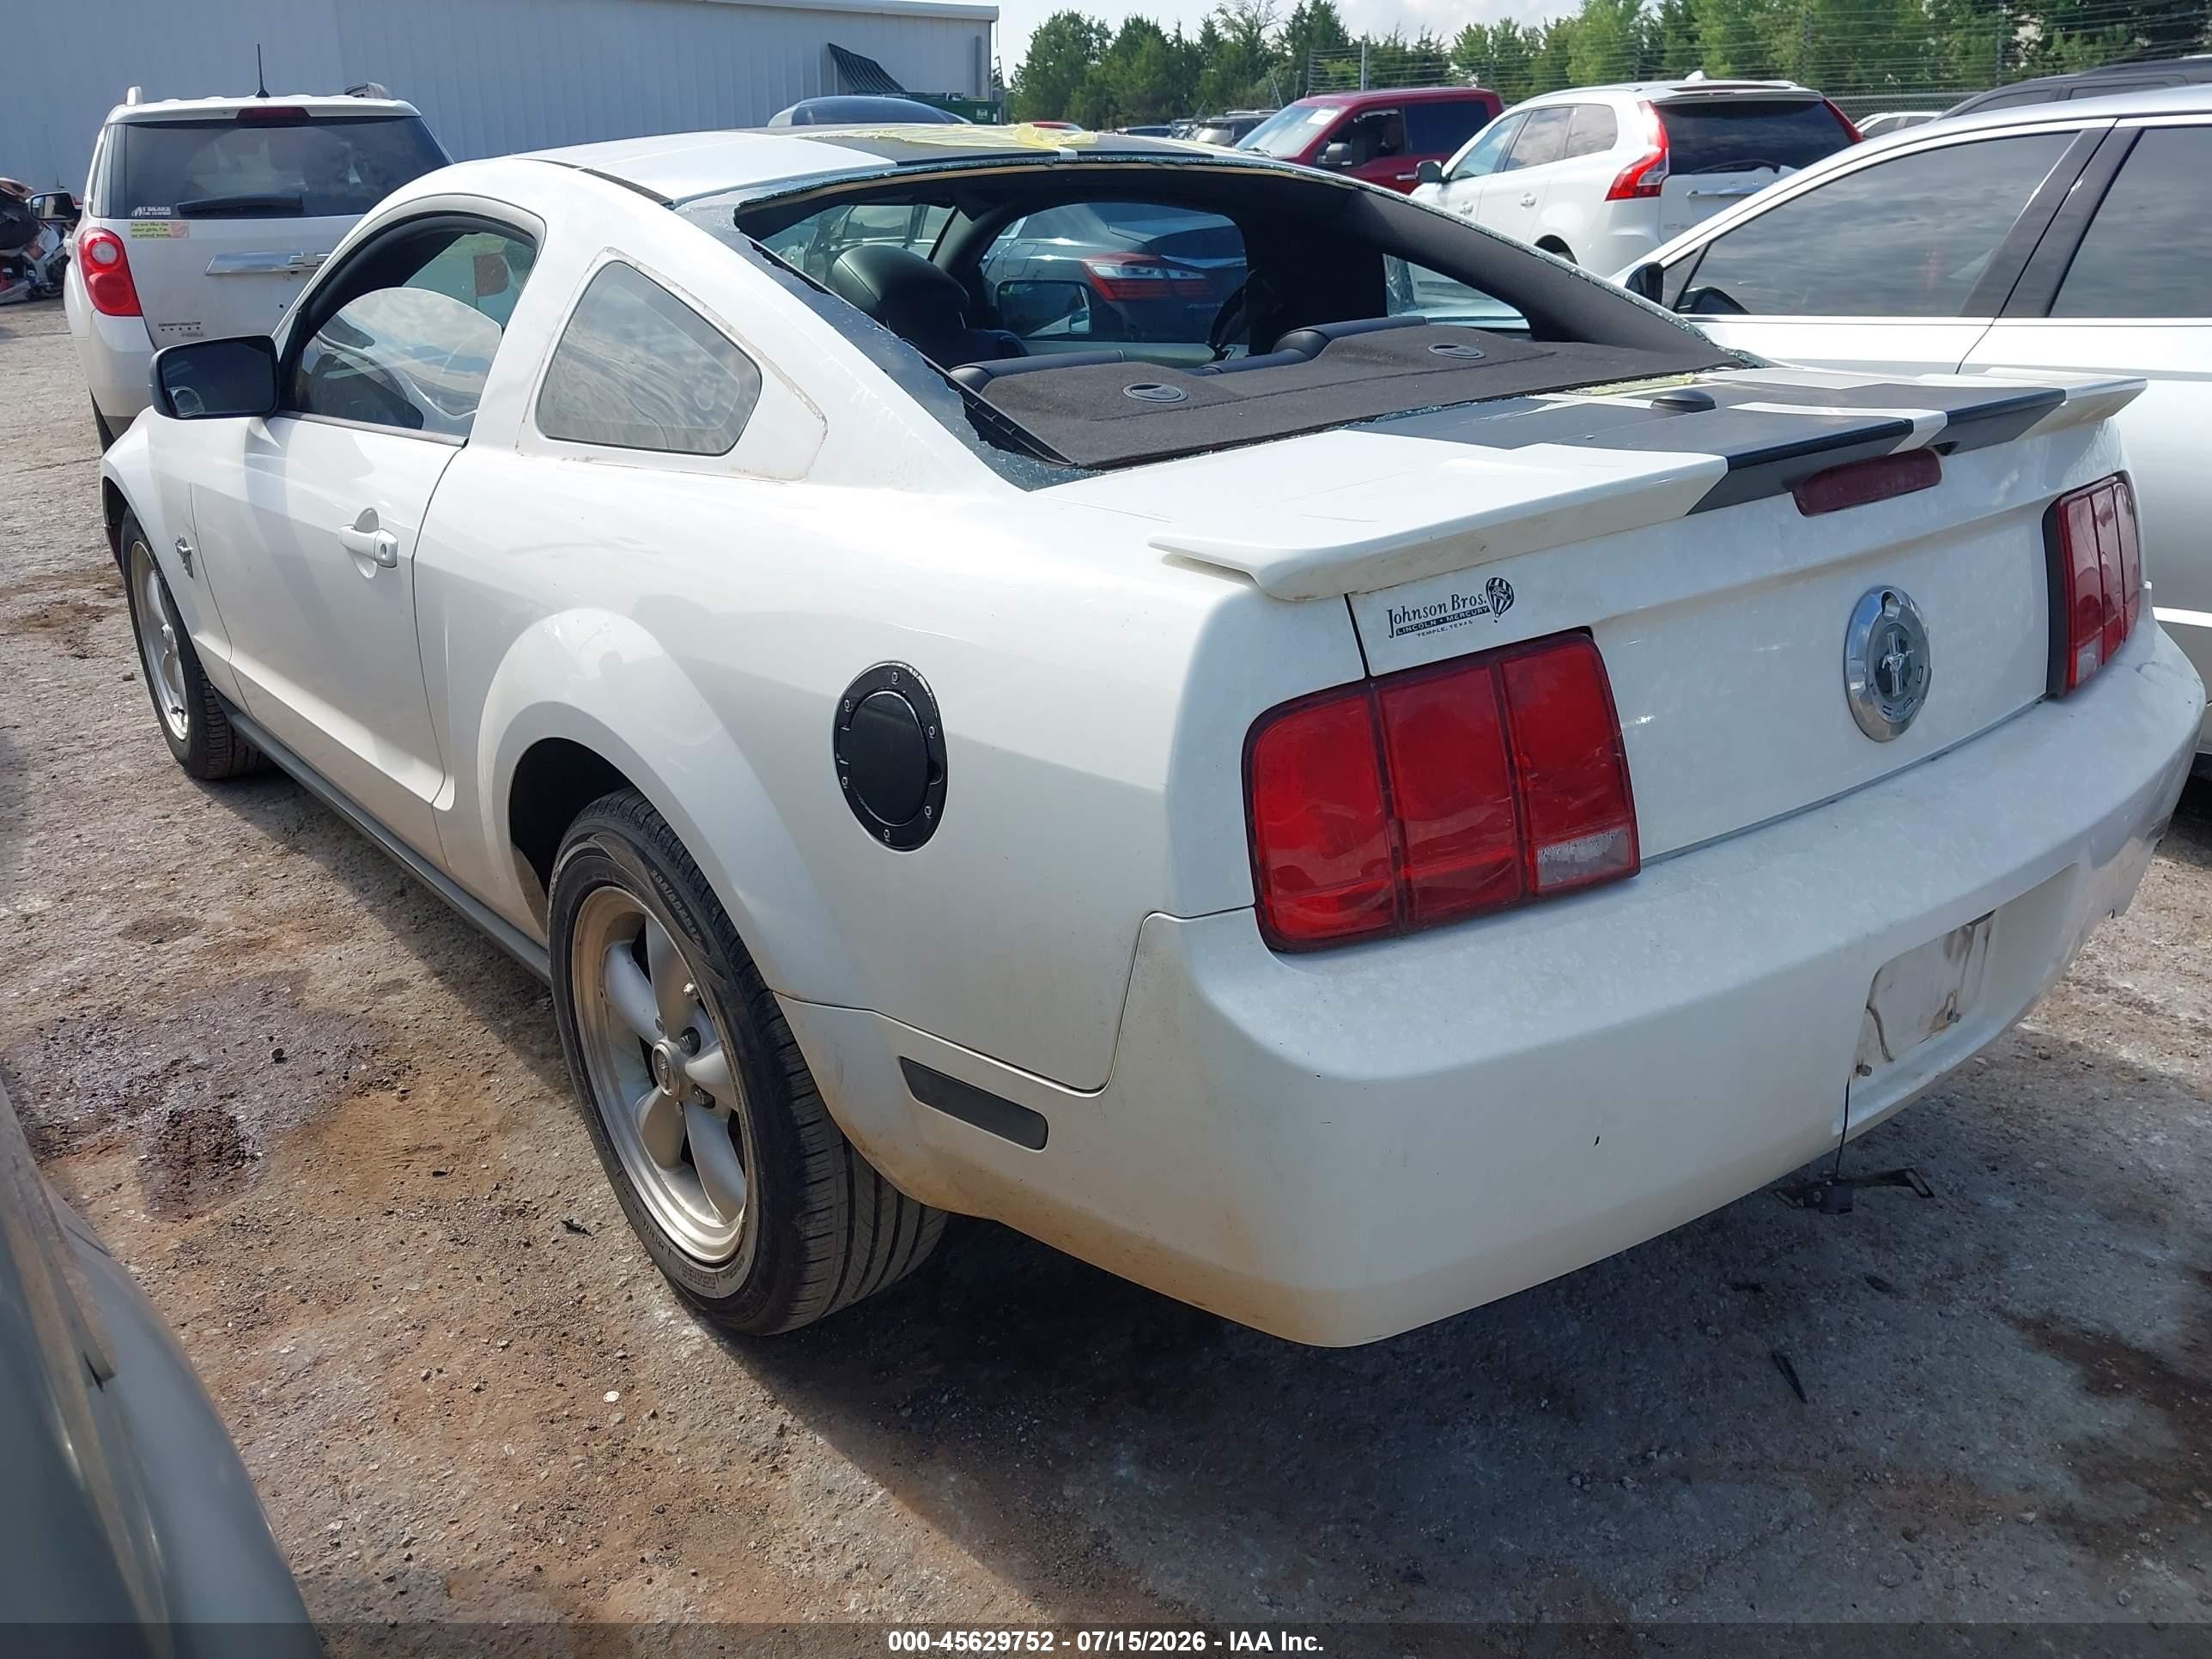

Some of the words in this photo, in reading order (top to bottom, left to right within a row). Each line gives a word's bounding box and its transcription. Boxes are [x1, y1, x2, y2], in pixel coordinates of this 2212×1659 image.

[1387, 603, 1449, 639] Johnson
[1451, 593, 1487, 611] Bros.
[1397, 619, 1437, 635] LINCOLN
[1446, 606, 1488, 623] MERCURY
